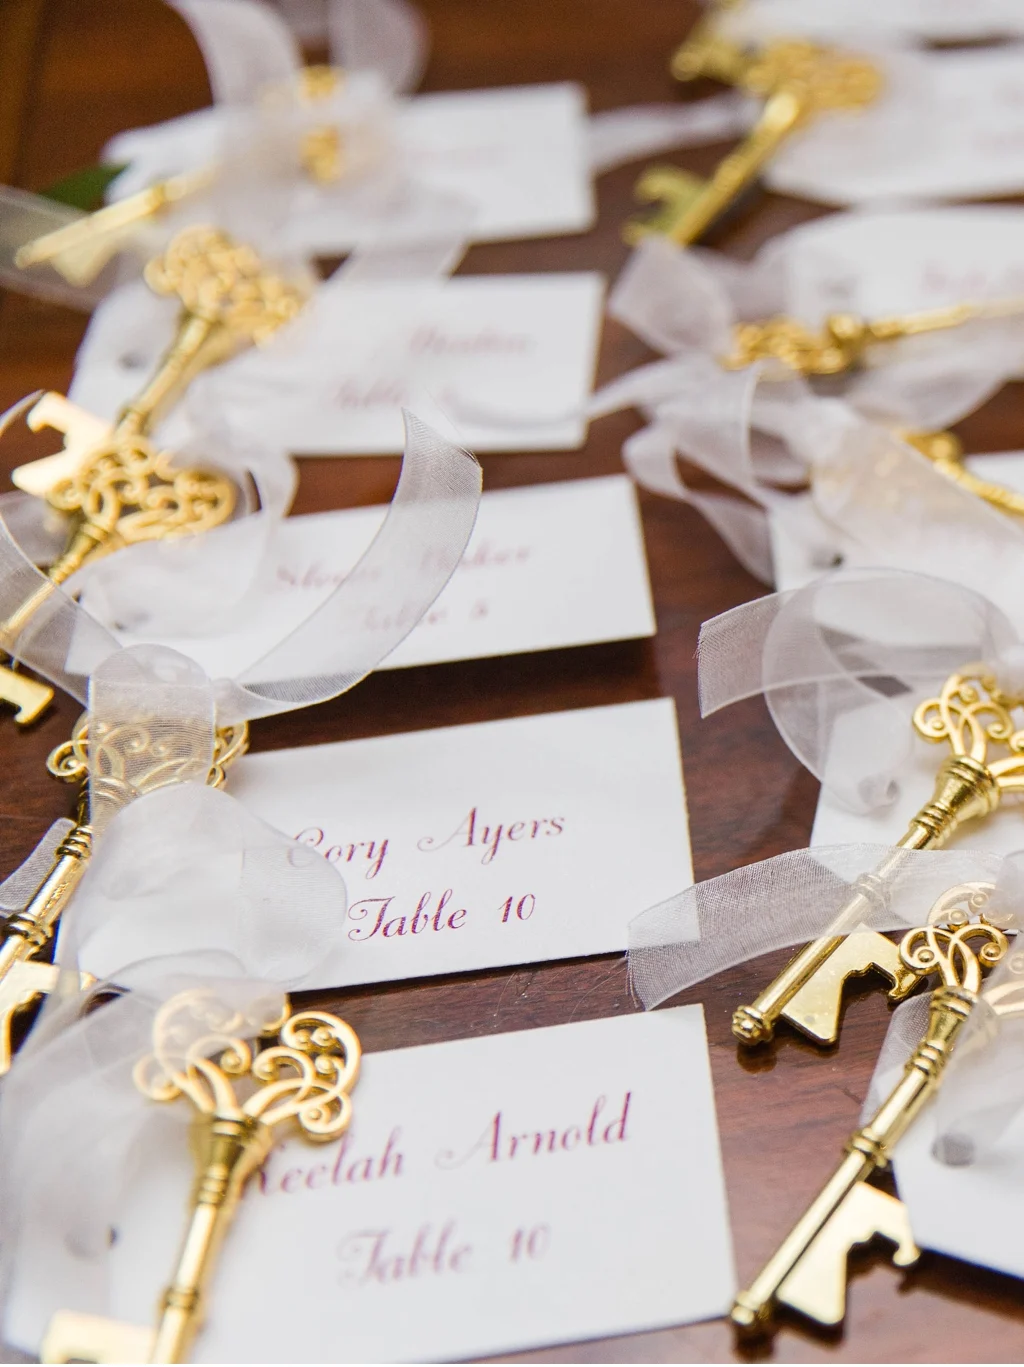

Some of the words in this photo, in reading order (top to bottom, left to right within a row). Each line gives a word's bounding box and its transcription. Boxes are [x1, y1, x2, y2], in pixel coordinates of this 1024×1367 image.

[286, 826, 389, 879] Cory
[417, 806, 566, 865] Ayers
[348, 888, 468, 942] Table
[498, 893, 537, 924] 10
[434, 1091, 632, 1169] Arnold
[335, 1217, 473, 1290] Table
[509, 1222, 552, 1264] 10
